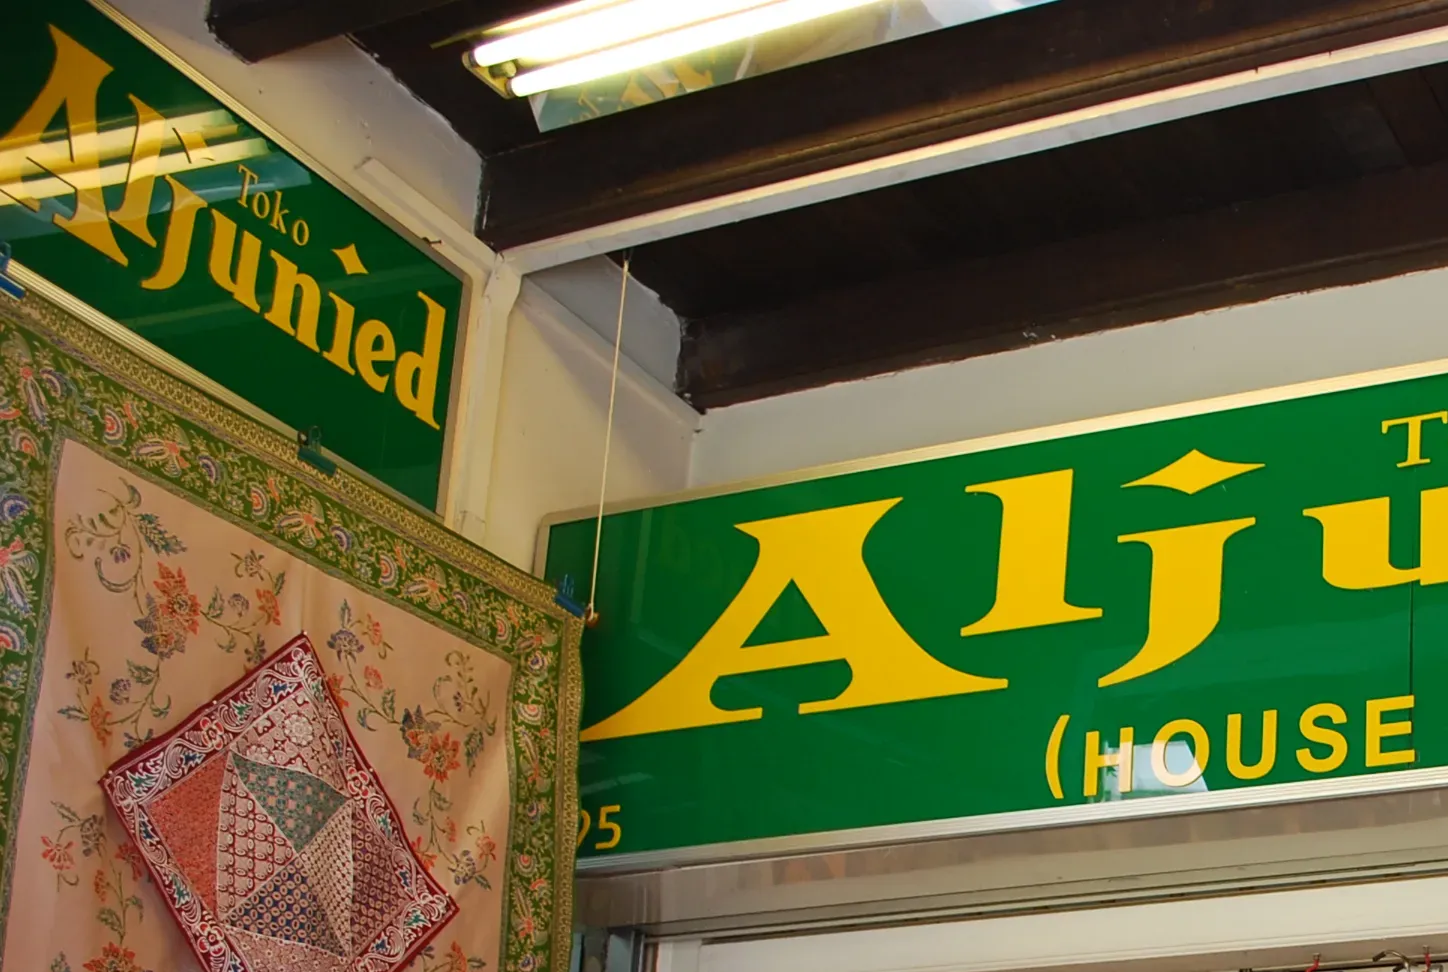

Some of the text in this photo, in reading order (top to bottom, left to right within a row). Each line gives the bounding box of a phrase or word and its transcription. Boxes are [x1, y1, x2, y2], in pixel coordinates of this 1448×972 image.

[0, 24, 445, 430] Aljunied
[238, 164, 309, 246] Toko
[1045, 694, 1416, 799] (HOUSE
